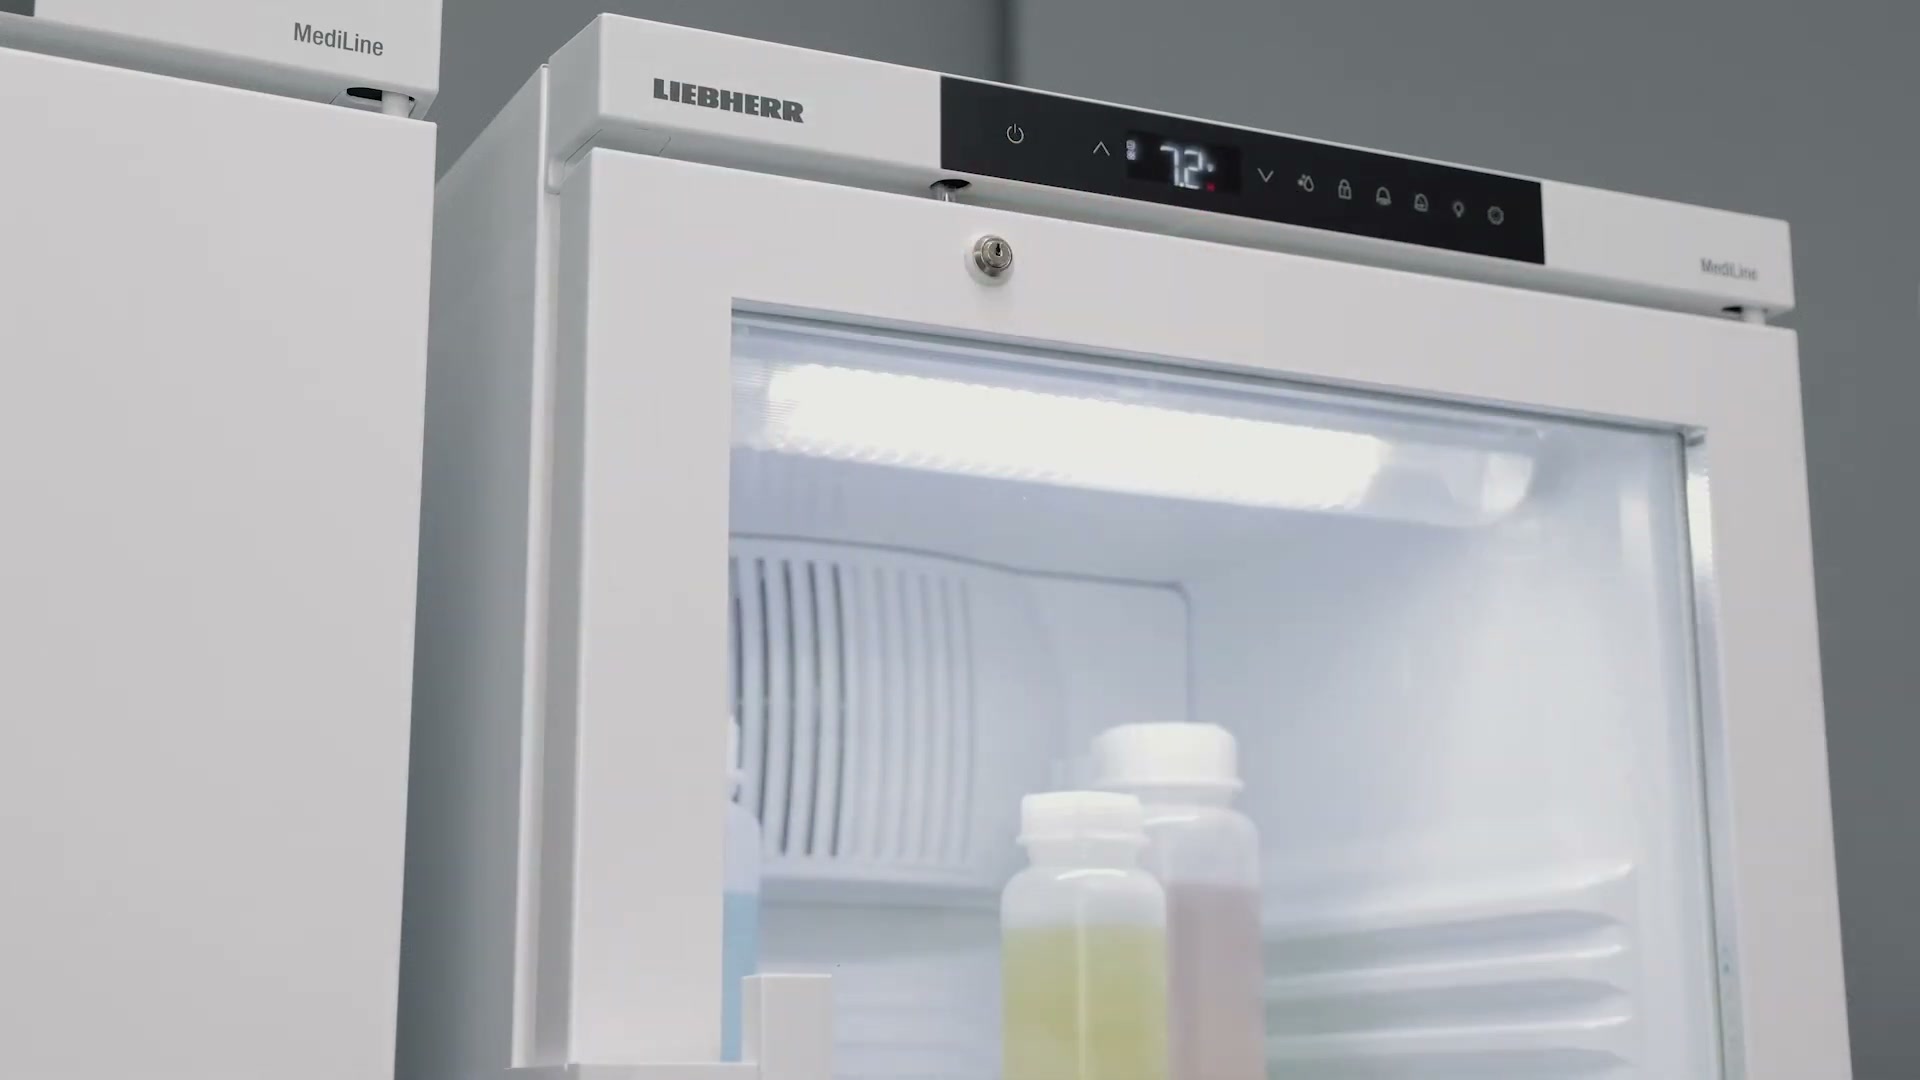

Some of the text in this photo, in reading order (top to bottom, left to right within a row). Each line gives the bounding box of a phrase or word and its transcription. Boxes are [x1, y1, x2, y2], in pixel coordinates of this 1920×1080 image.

[293, 22, 384, 57] MediLine
[653, 77, 805, 124] LIEBHERR
[1700, 257, 1758, 281] MediLine
